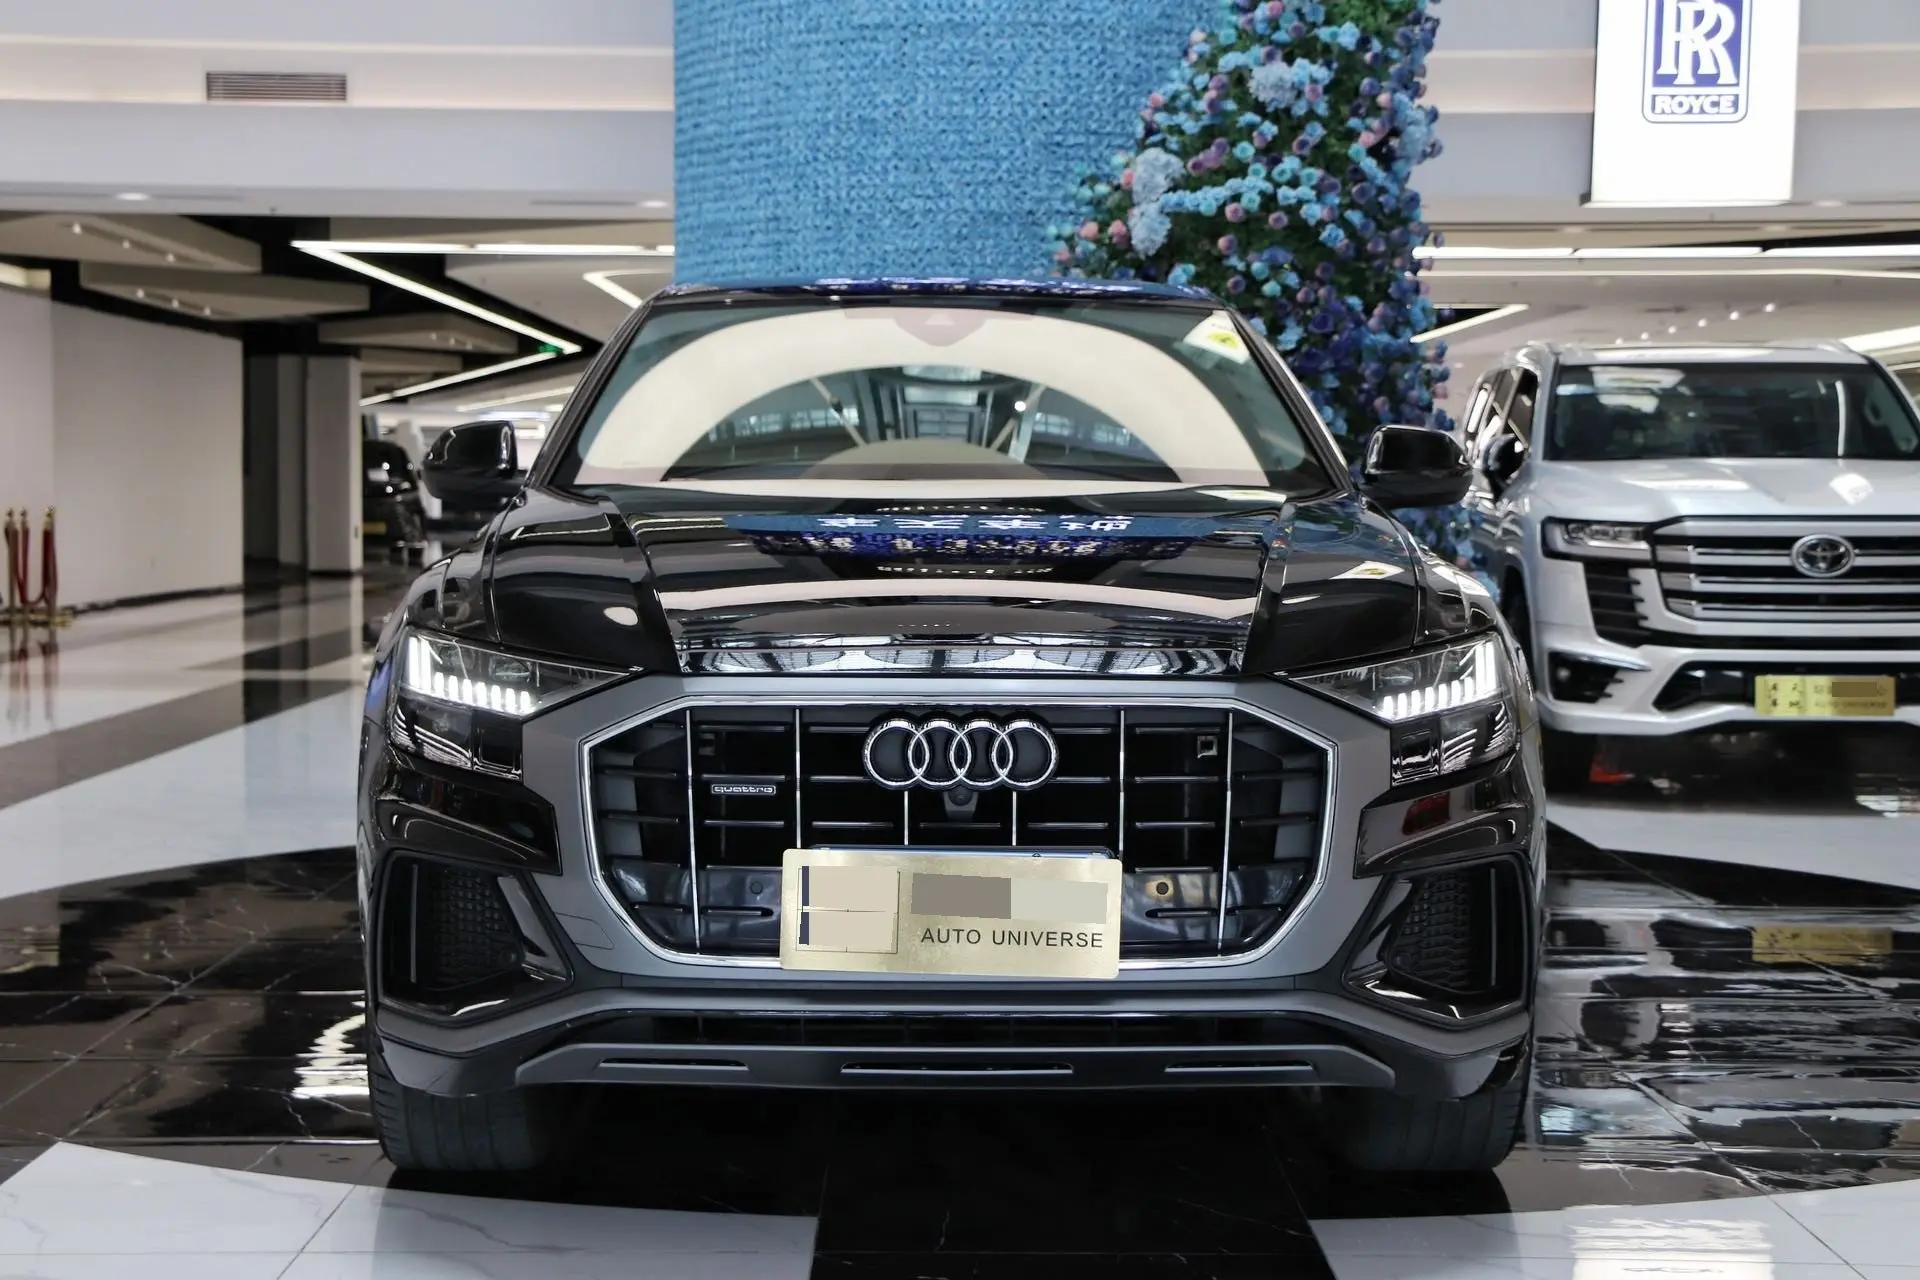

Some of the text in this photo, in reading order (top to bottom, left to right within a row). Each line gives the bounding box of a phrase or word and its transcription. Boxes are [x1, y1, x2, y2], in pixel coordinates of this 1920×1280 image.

[1654, 95, 1736, 114] ROYCE
[713, 785, 774, 793] quattro
[921, 928, 1103, 948] AUTO UNIVERSE
